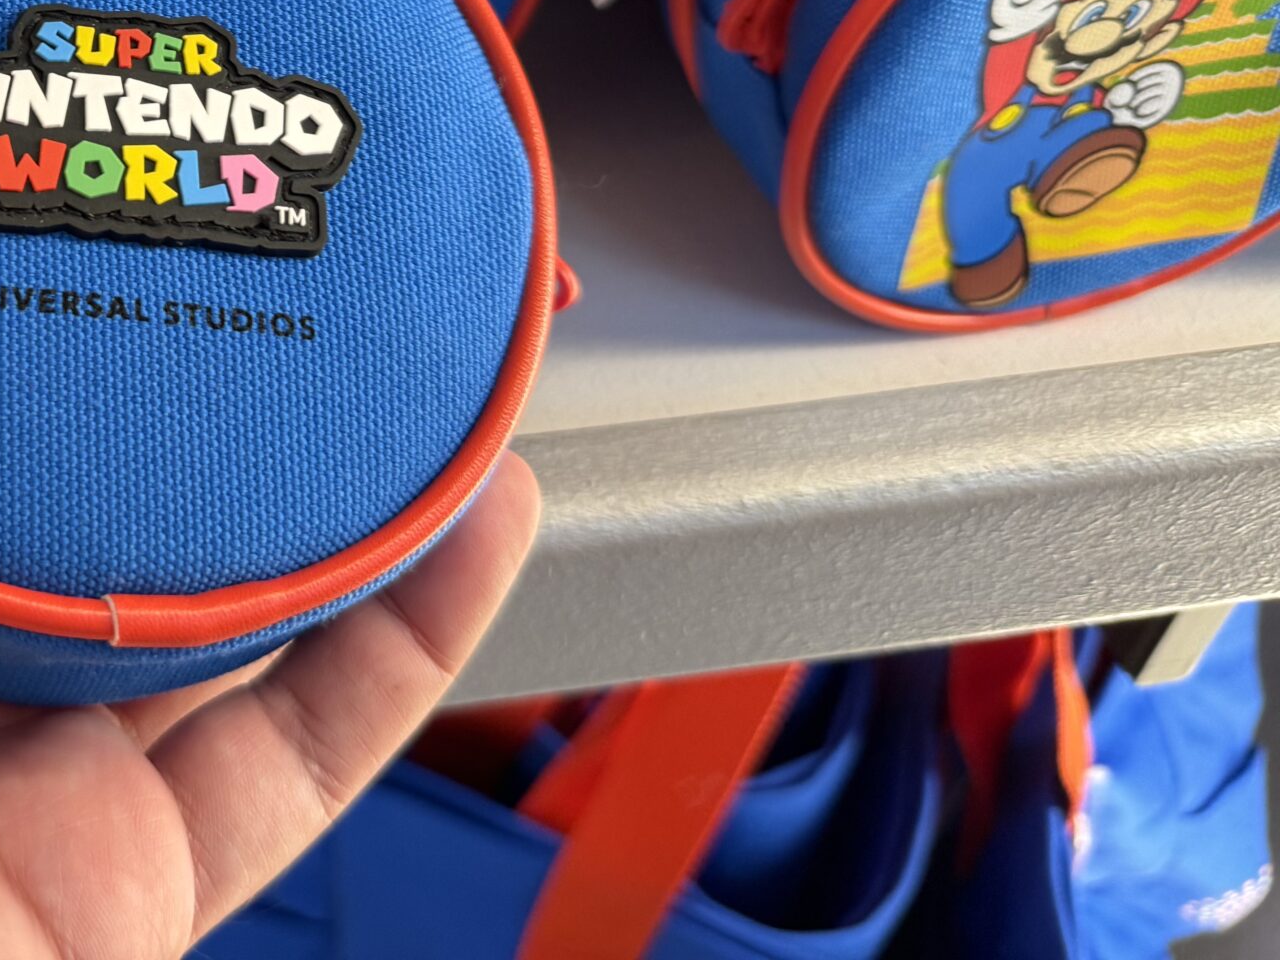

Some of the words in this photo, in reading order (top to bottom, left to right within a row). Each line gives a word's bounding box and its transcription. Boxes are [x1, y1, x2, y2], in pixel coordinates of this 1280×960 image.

[35, 20, 222, 77] SUPER
[274, 205, 307, 227] TM
[163, 301, 317, 341] STUDIOS
